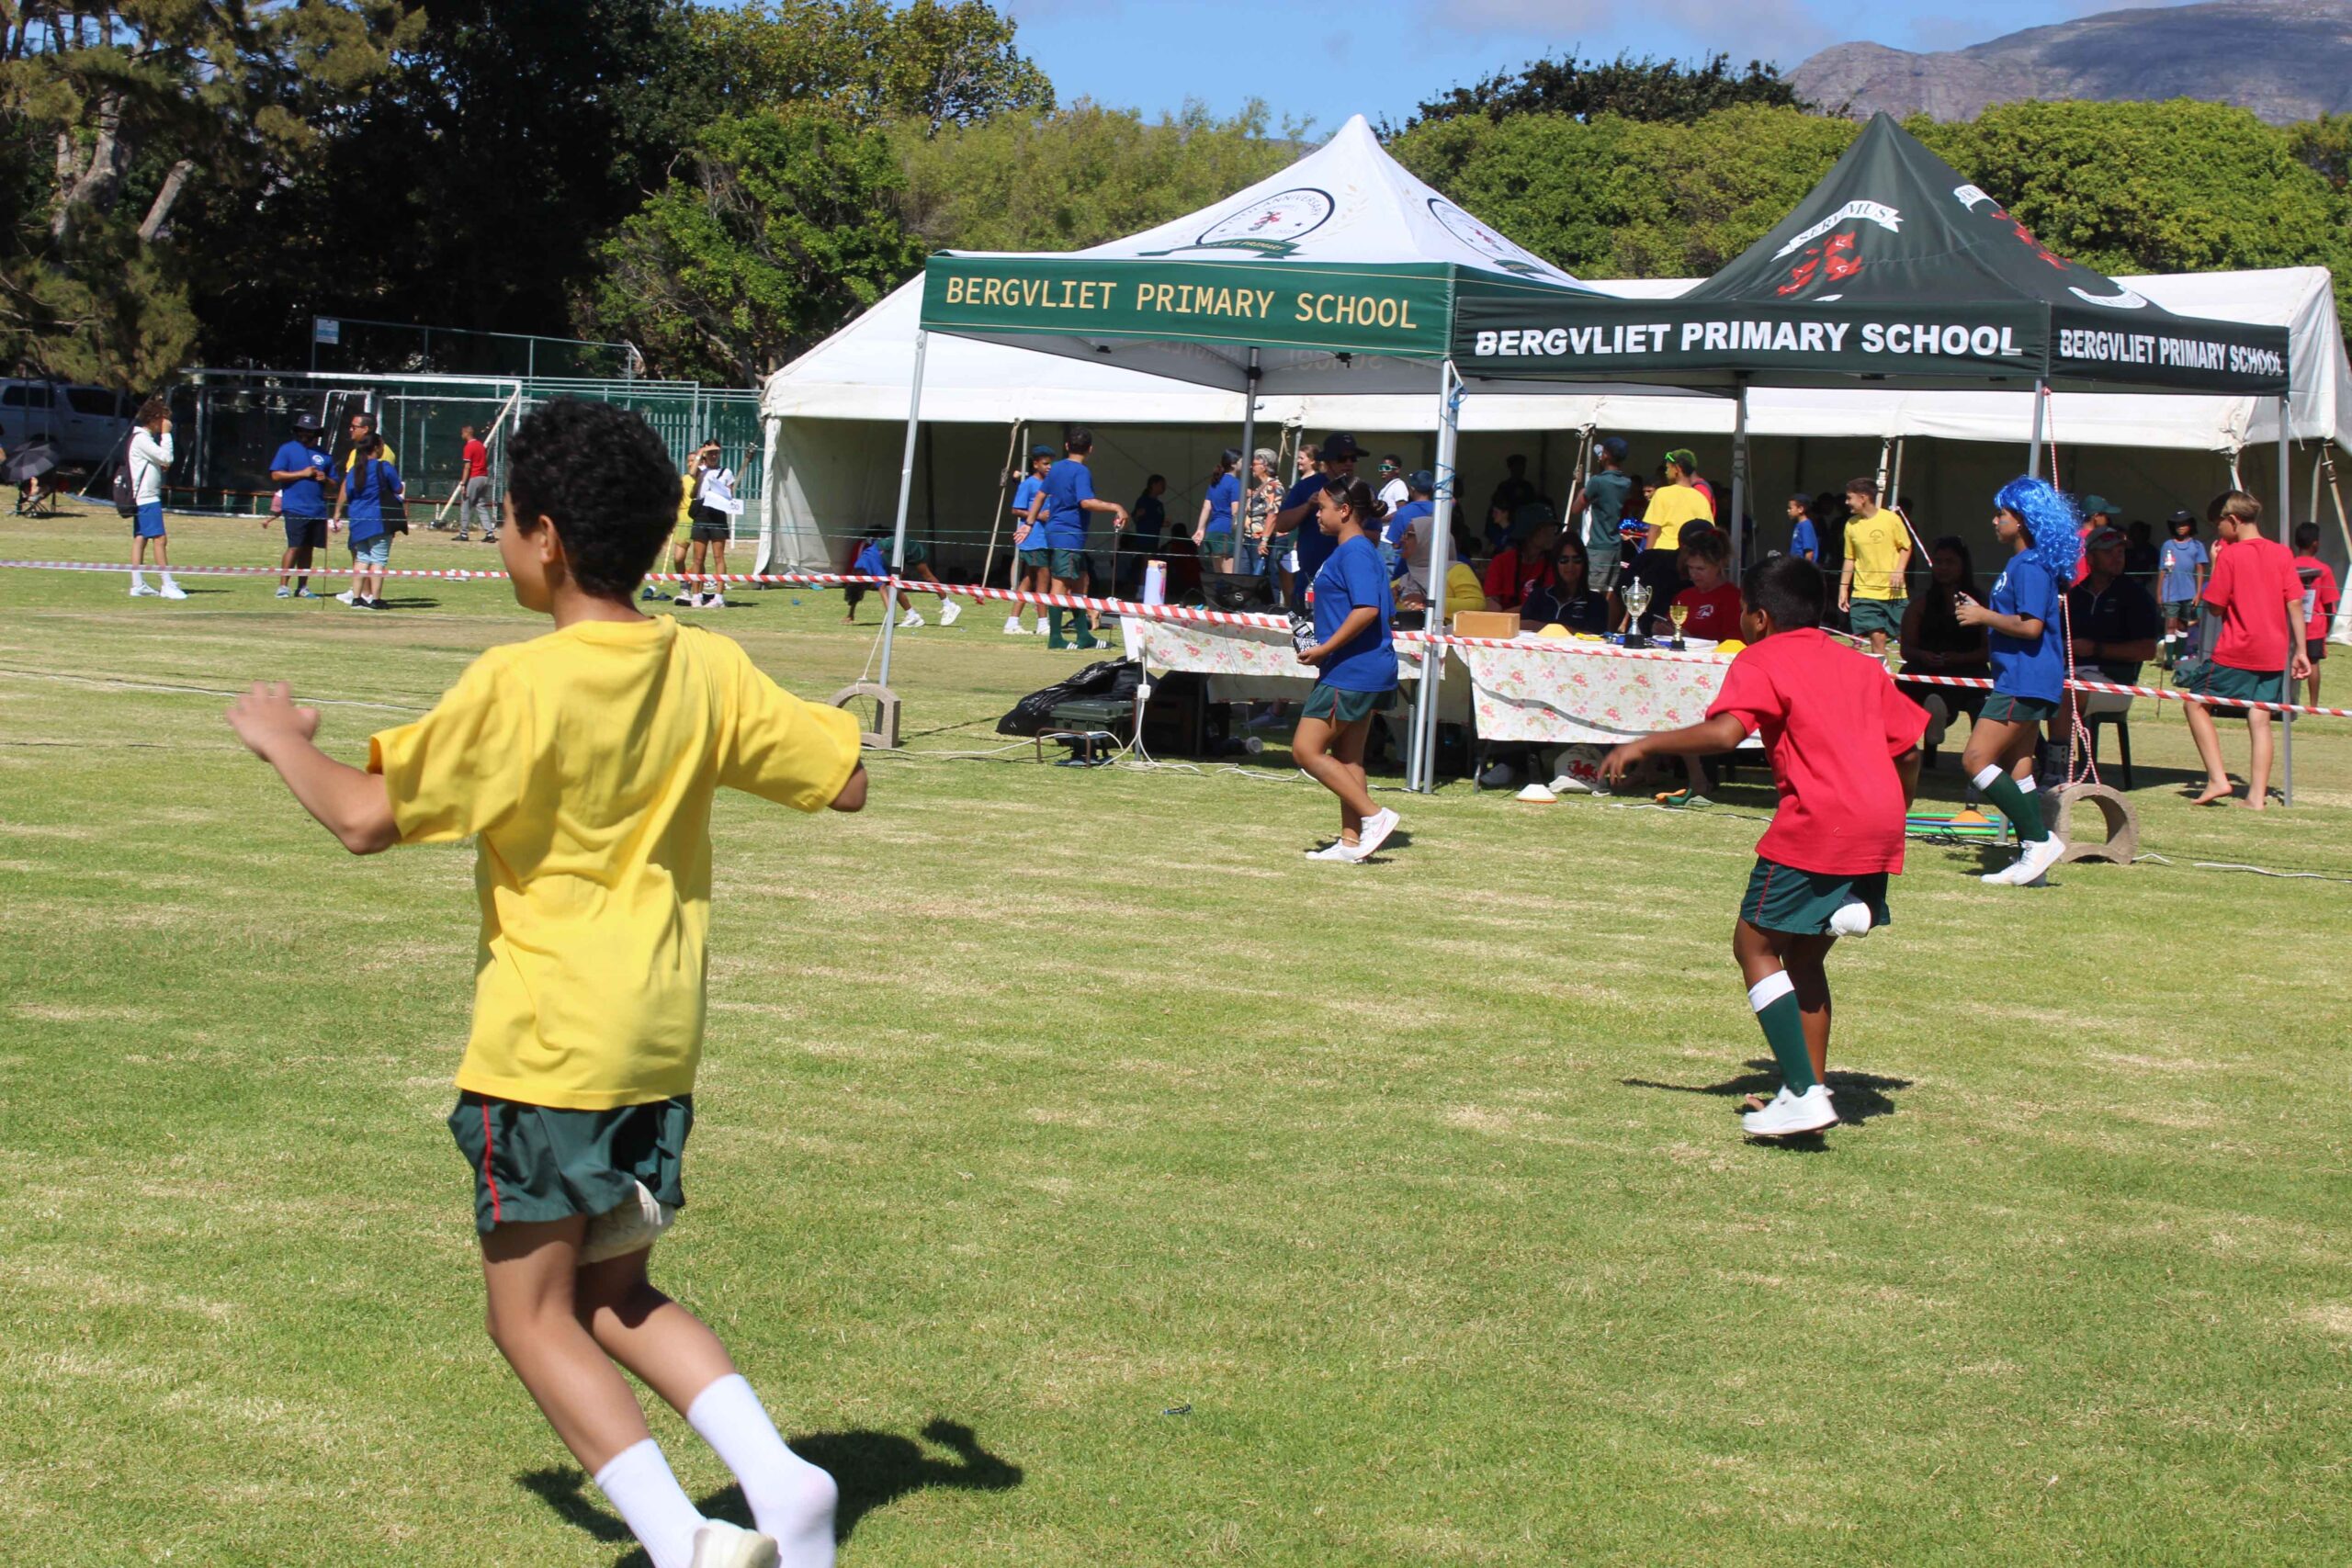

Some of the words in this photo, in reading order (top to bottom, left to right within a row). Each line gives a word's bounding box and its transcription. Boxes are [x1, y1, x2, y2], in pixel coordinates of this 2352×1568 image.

[1798, 203, 1889, 244] SERVIMUS
[946, 276, 1117, 310] BERGVLIET
[1136, 283, 1275, 319] PRIMARY
[1295, 292, 1418, 329] SCHOOL
[1475, 324, 1671, 356] BERGVLIET
[1680, 321, 1850, 352] PRIMARY
[1860, 322, 2022, 356] SCHOOL
[2060, 329, 2155, 364] BERGVLIET
[2159, 337, 2226, 371] PRIMARY
[2229, 344, 2285, 377] SCHOOL
